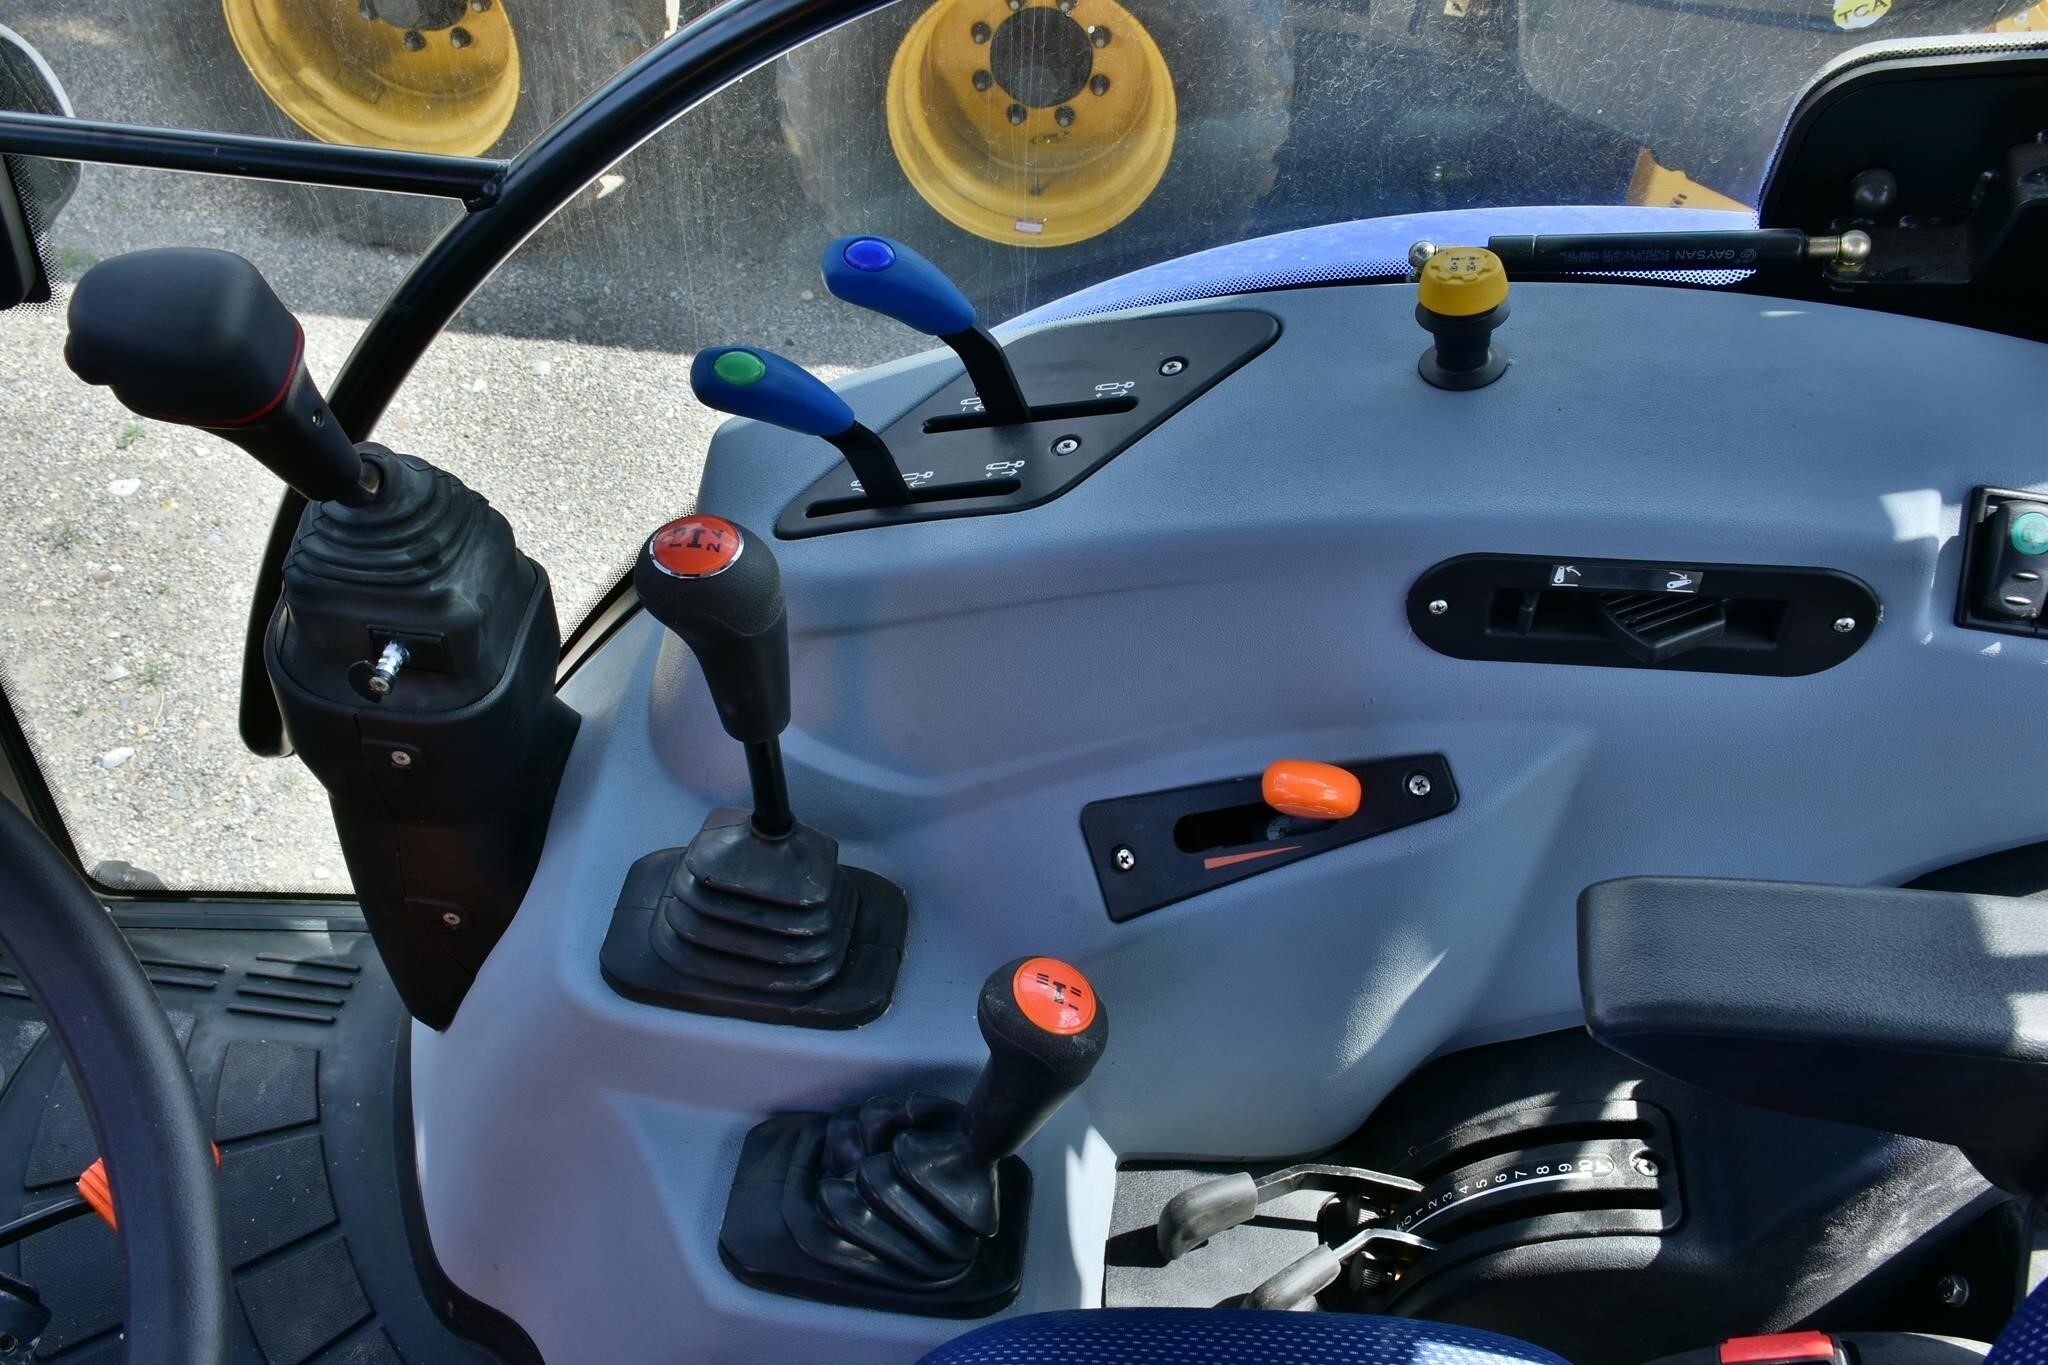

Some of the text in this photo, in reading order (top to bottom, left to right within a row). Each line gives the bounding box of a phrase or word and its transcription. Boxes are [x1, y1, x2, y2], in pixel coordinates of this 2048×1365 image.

[1838, 0, 1888, 23] TCA
[1675, 249, 1736, 260] GAYSAN
[1415, 1207, 1423, 1216] 1
[1428, 1199, 1437, 1210] 2
[1442, 1192, 1453, 1202] 3
[1458, 1185, 1469, 1194] 4
[1476, 1178, 1488, 1190] 5
[1494, 1173, 1507, 1184] 6
[1514, 1169, 1528, 1180] 7
[1536, 1165, 1550, 1175] 8
[1558, 1163, 1572, 1172] 9
[1579, 1159, 1593, 1173] 10
